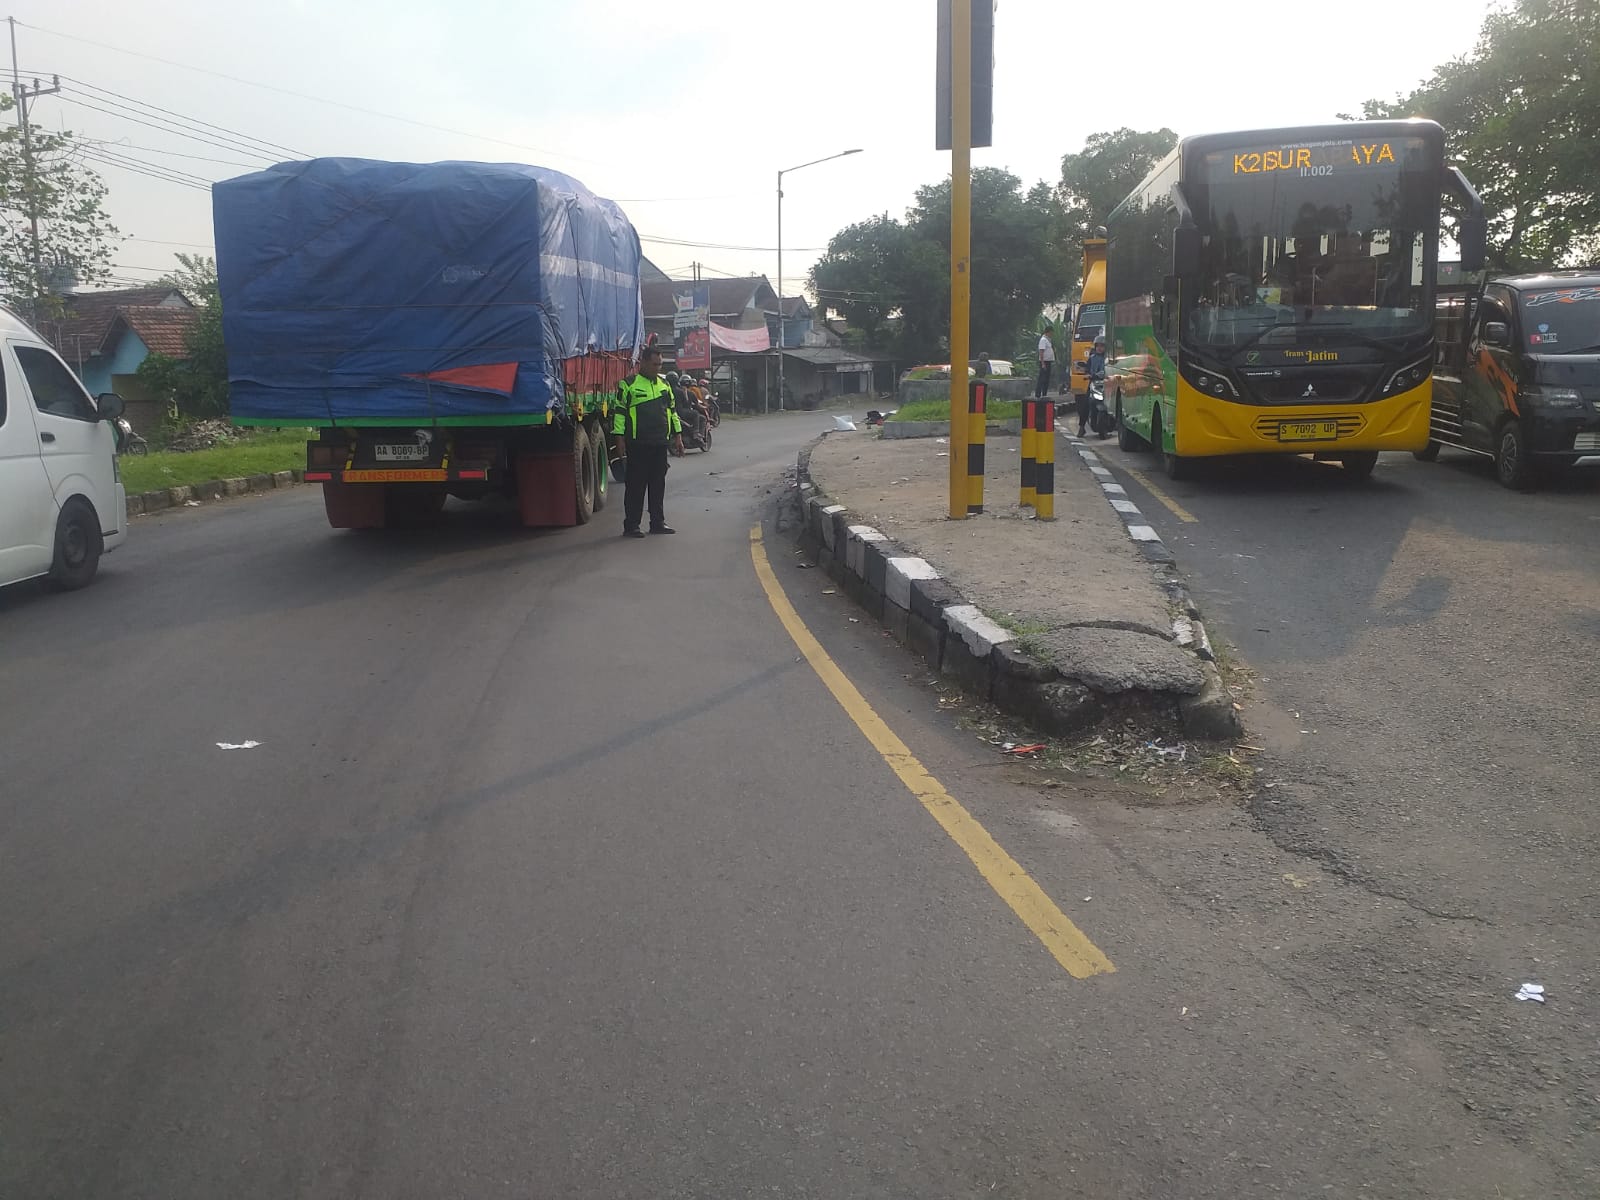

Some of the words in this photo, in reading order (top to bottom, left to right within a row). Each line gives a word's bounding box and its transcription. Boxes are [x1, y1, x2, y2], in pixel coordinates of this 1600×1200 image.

[1283, 350, 1303, 358] Trans
[1305, 350, 1338, 363] Jatim
[1281, 425, 1287, 435] S
[1323, 423, 1335, 433] UP
[376, 446, 388, 456] AA
